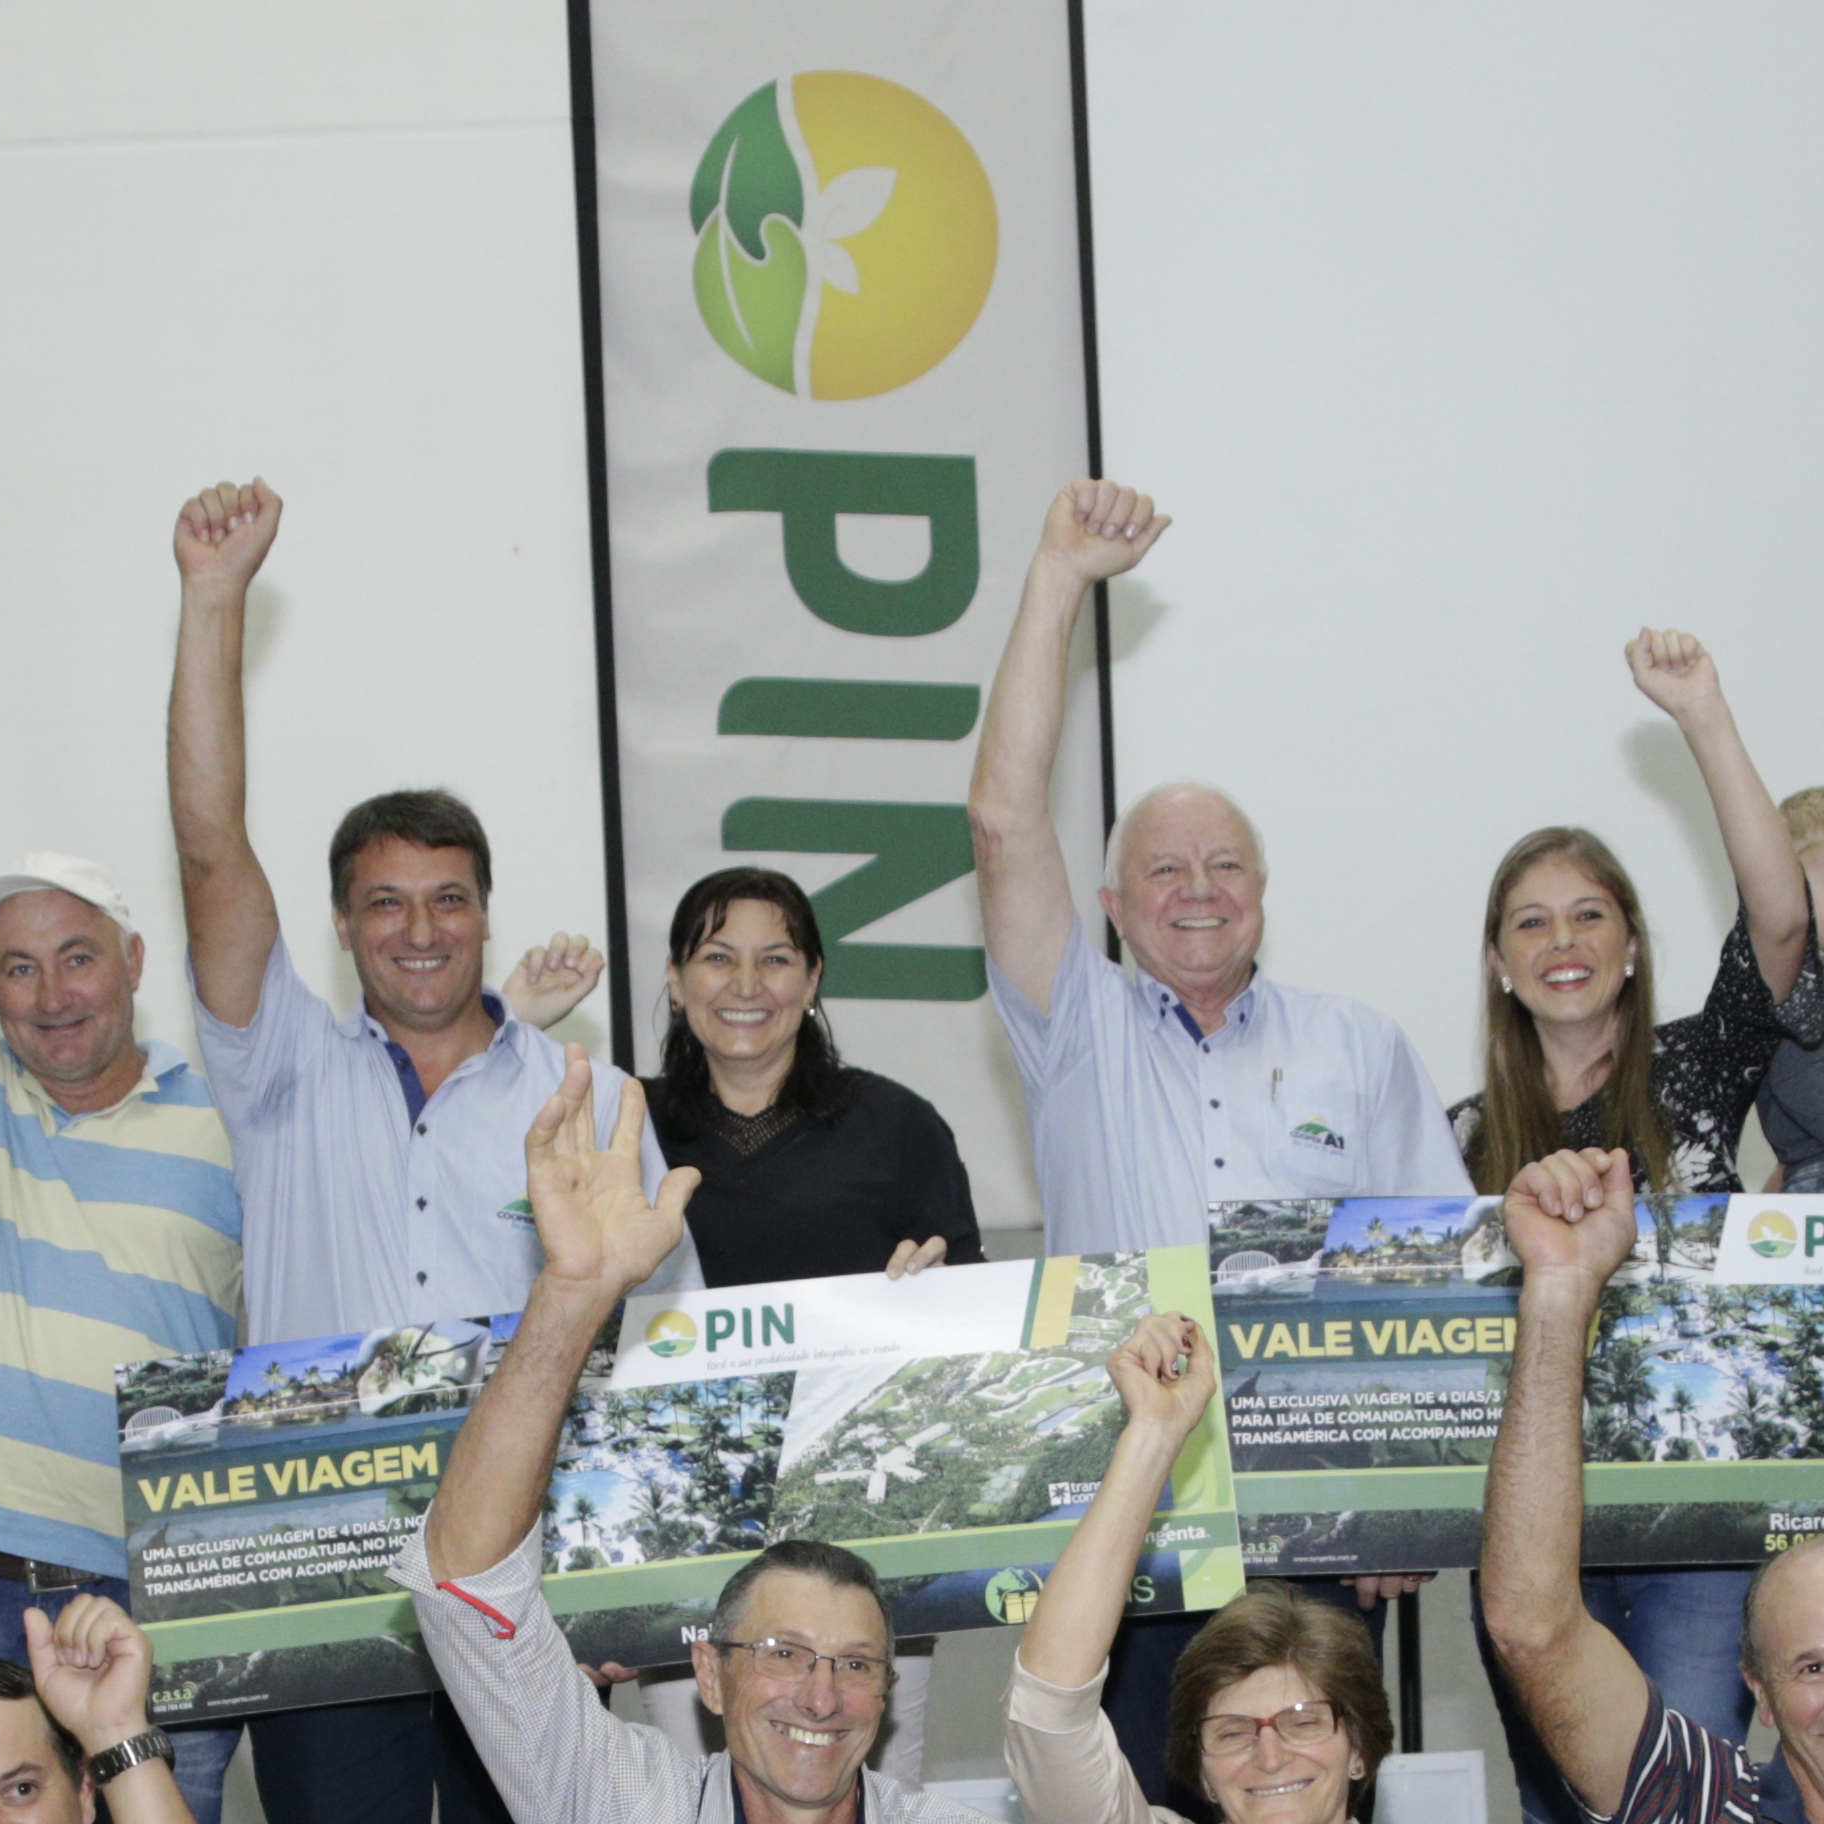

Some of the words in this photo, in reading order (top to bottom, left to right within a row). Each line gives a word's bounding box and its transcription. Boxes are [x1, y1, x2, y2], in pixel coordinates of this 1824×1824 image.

[706, 446, 989, 1002] PIN
[705, 1303, 795, 1353] PIN
[1230, 1322, 1353, 1360] VALE
[1361, 1316, 1518, 1356] VIAGE
[1232, 1397, 1265, 1410] UMA
[1269, 1394, 1351, 1408] EXCLUSIVA
[1354, 1392, 1412, 1406] VIAGEM
[1414, 1391, 1434, 1404] DE
[1437, 1391, 1448, 1404] 4
[1451, 1389, 1501, 1405] DIAS/3
[1233, 1414, 1274, 1427] PARA
[1277, 1413, 1311, 1426] ILHA
[1314, 1412, 1334, 1425] DE
[1337, 1408, 1459, 1424] COMANDATUBA,
[1461, 1408, 1484, 1420] NO
[1233, 1427, 1350, 1445] TRANSAMÉRICA
[1352, 1428, 1387, 1442] COM
[1390, 1425, 1499, 1440] ACOMPANHAN
[139, 1466, 256, 1512] VALE
[263, 1442, 438, 1497] VIAGEM
[143, 1547, 174, 1562] UMA
[178, 1537, 257, 1557] EXCLUSIVA
[259, 1529, 314, 1548] VIAGEM
[317, 1525, 337, 1540] DE
[339, 1524, 350, 1537] 4
[352, 1516, 402, 1536] DIAS/3
[1145, 1525, 1205, 1548] ngenta
[144, 1563, 182, 1579] PARA
[186, 1558, 219, 1574] ILHA
[222, 1555, 241, 1569] DE
[244, 1543, 362, 1566] COMANDATUBA,
[363, 1538, 386, 1552] NO
[145, 1572, 257, 1596] TRANSAMÉRICA
[261, 1566, 293, 1581] COM
[296, 1554, 397, 1577] ACOMPANHAN
